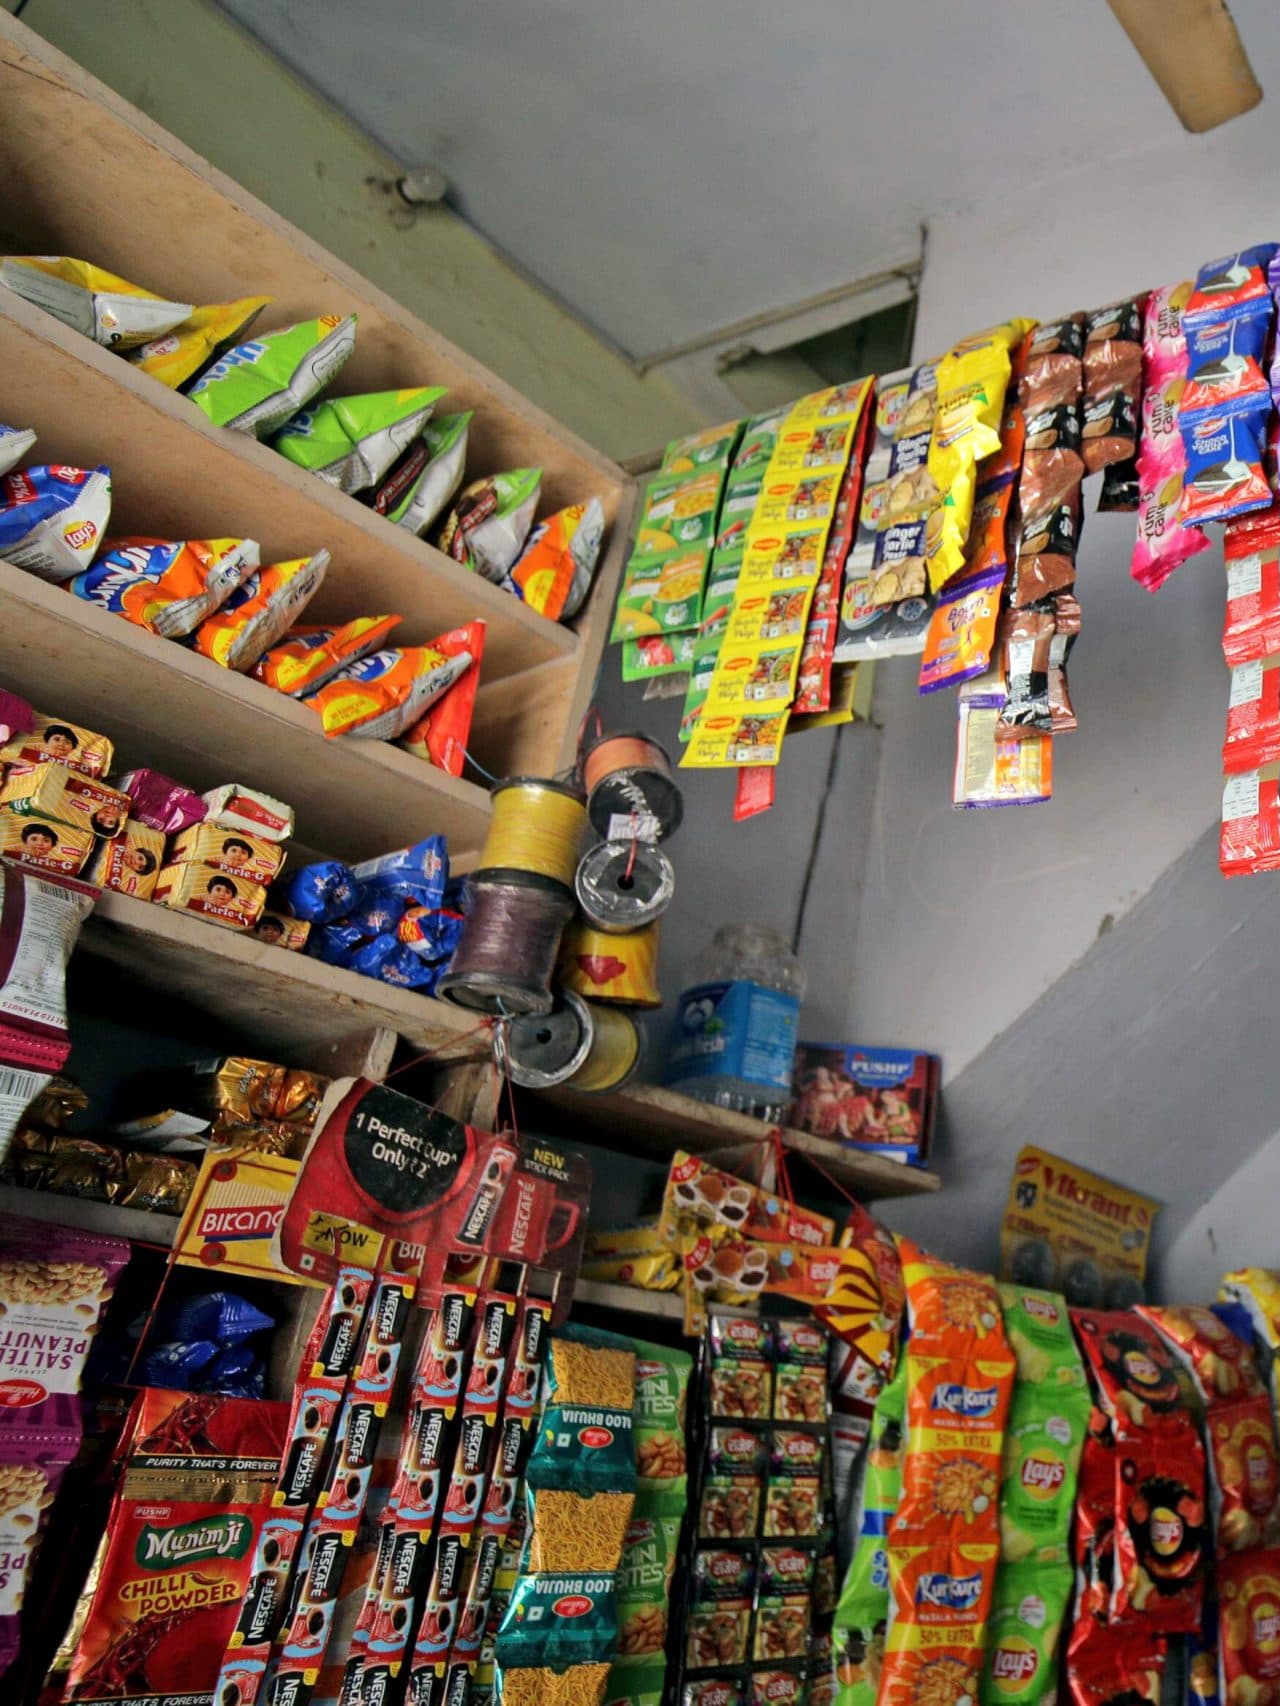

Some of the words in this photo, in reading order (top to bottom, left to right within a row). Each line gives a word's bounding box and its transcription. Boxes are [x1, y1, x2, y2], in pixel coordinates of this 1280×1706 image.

[20, 853, 73, 871] Parle-G
[109, 844, 124, 885] Parle-G
[219, 863, 265, 882] Parle-G
[356, 1113, 364, 1128] 1
[367, 1117, 424, 1152] Perfect
[371, 1142, 411, 1172] Only
[533, 1147, 566, 1168] NEW
[0, 1330, 88, 1355] PEANUT
[934, 1382, 999, 1414] Kurkure
[561, 1408, 605, 1428] BHUJIA
[145, 1457, 188, 1469] PURITY
[190, 1458, 227, 1470] THAT'S
[229, 1460, 279, 1472] FOREVER
[135, 1507, 170, 1518] PUSHP
[145, 1518, 242, 1560] Munimji
[120, 1573, 187, 1600] CHILLI
[140, 1582, 239, 1615] POWDER
[535, 1578, 587, 1596] BHUJIA
[918, 1573, 983, 1606] Kurkure
